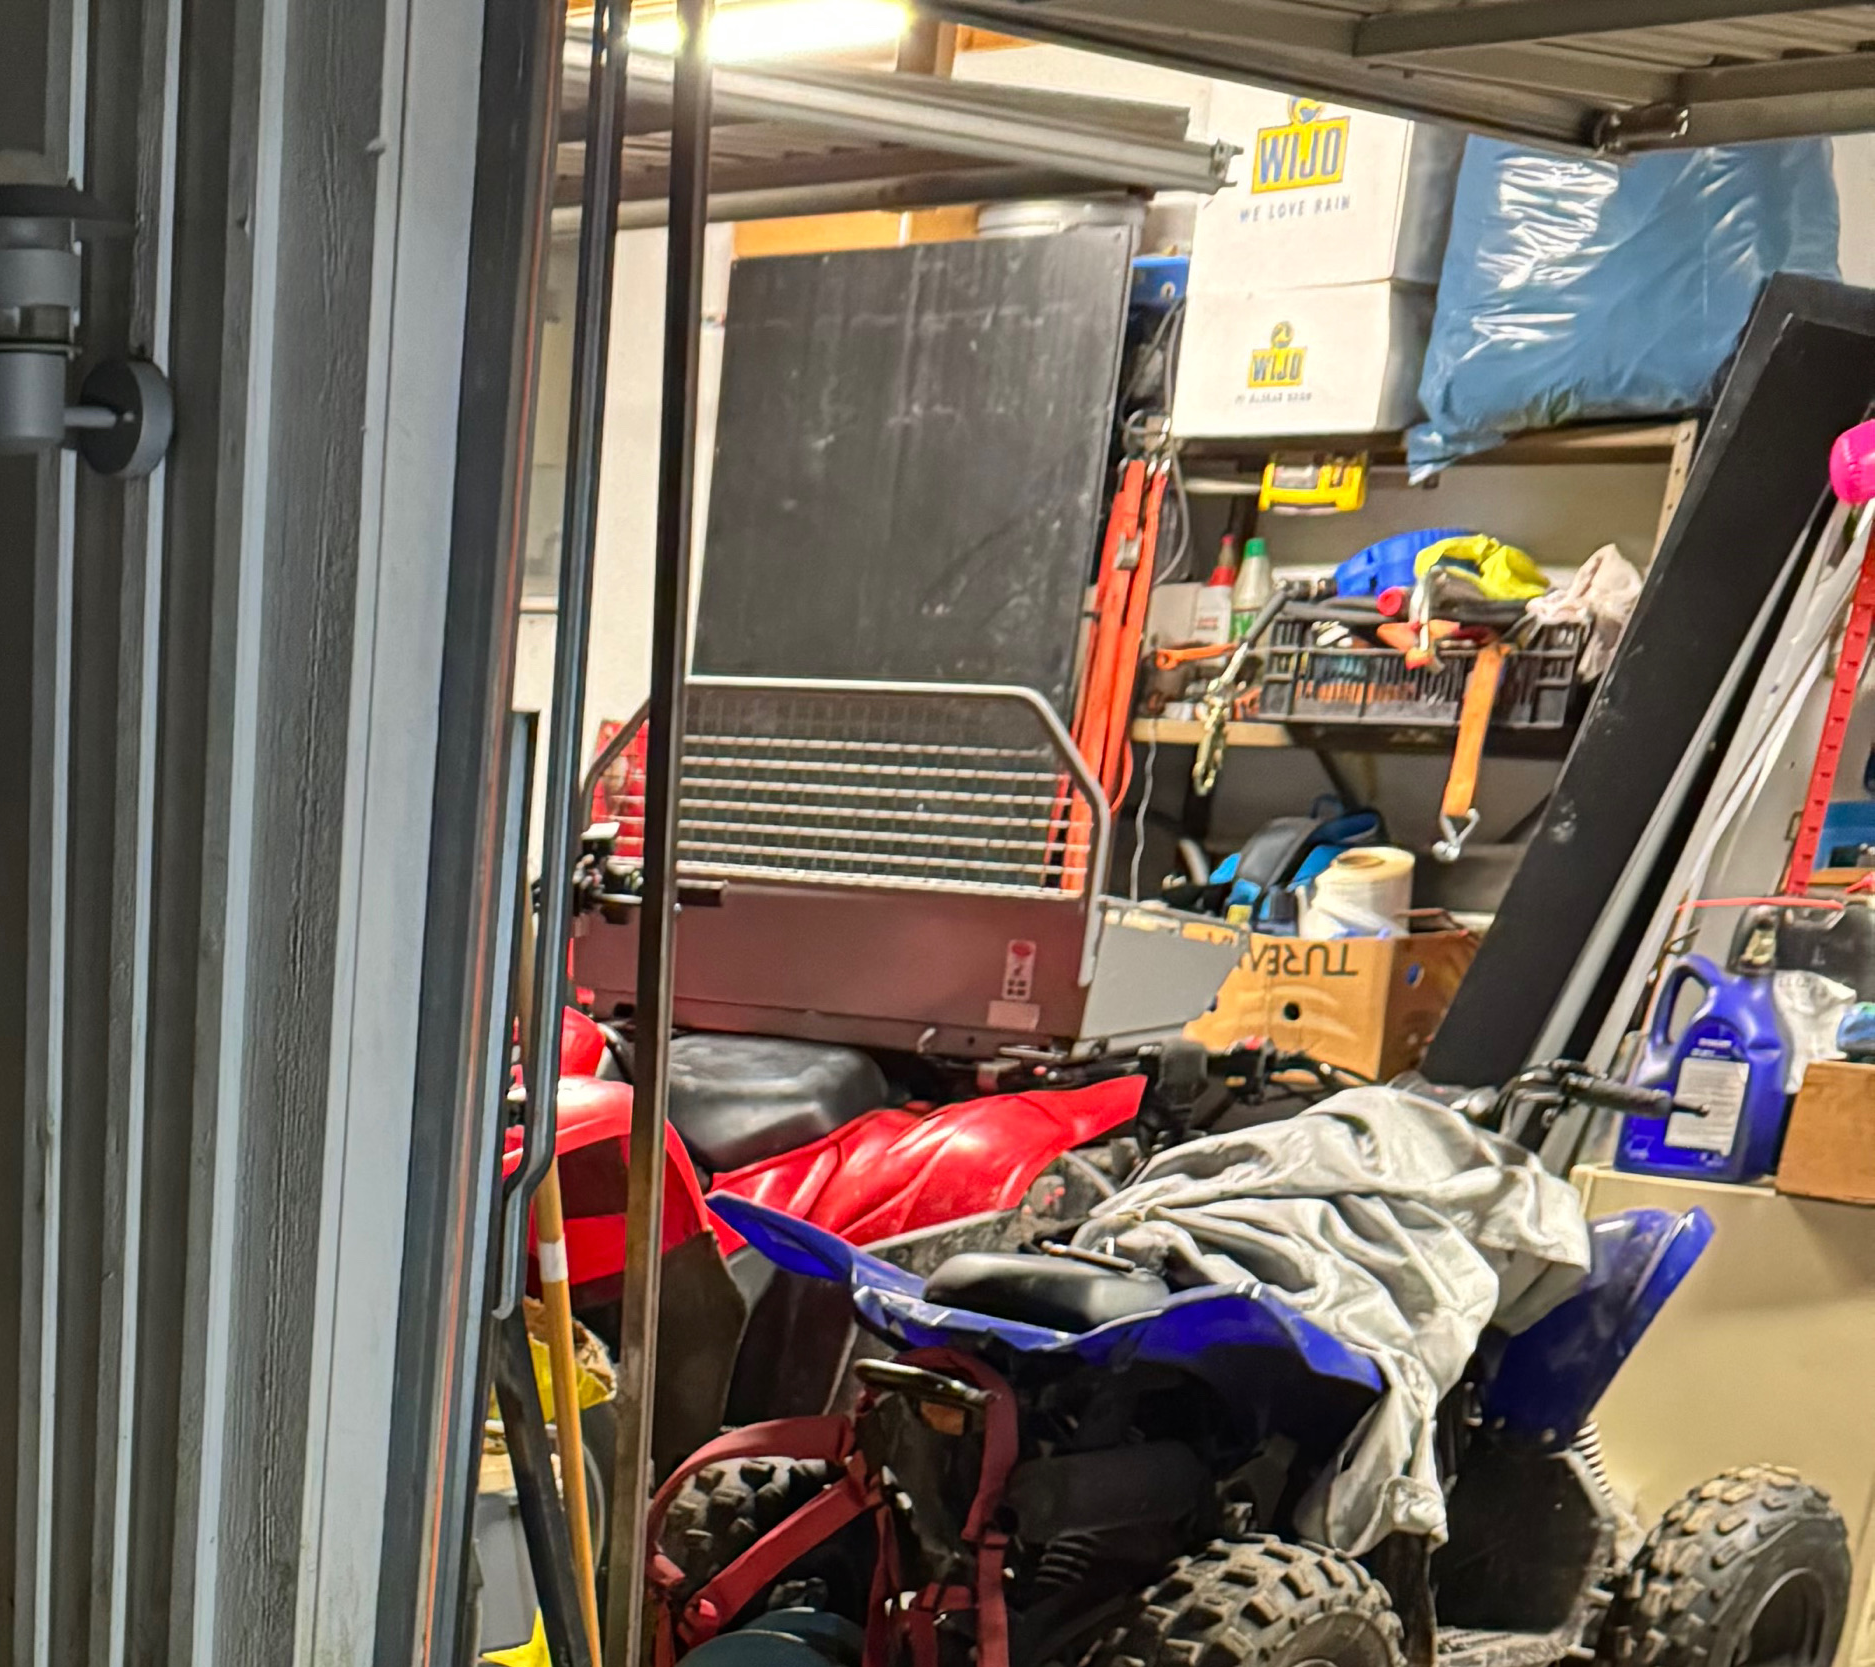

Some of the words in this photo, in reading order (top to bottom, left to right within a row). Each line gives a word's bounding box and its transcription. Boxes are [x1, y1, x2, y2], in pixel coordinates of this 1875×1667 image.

[1260, 127, 1342, 184] WIJO
[1239, 207, 1261, 224] WE
[1268, 199, 1305, 221] LOVE
[1314, 195, 1351, 215] RAIN
[1252, 352, 1303, 382] WIJO
